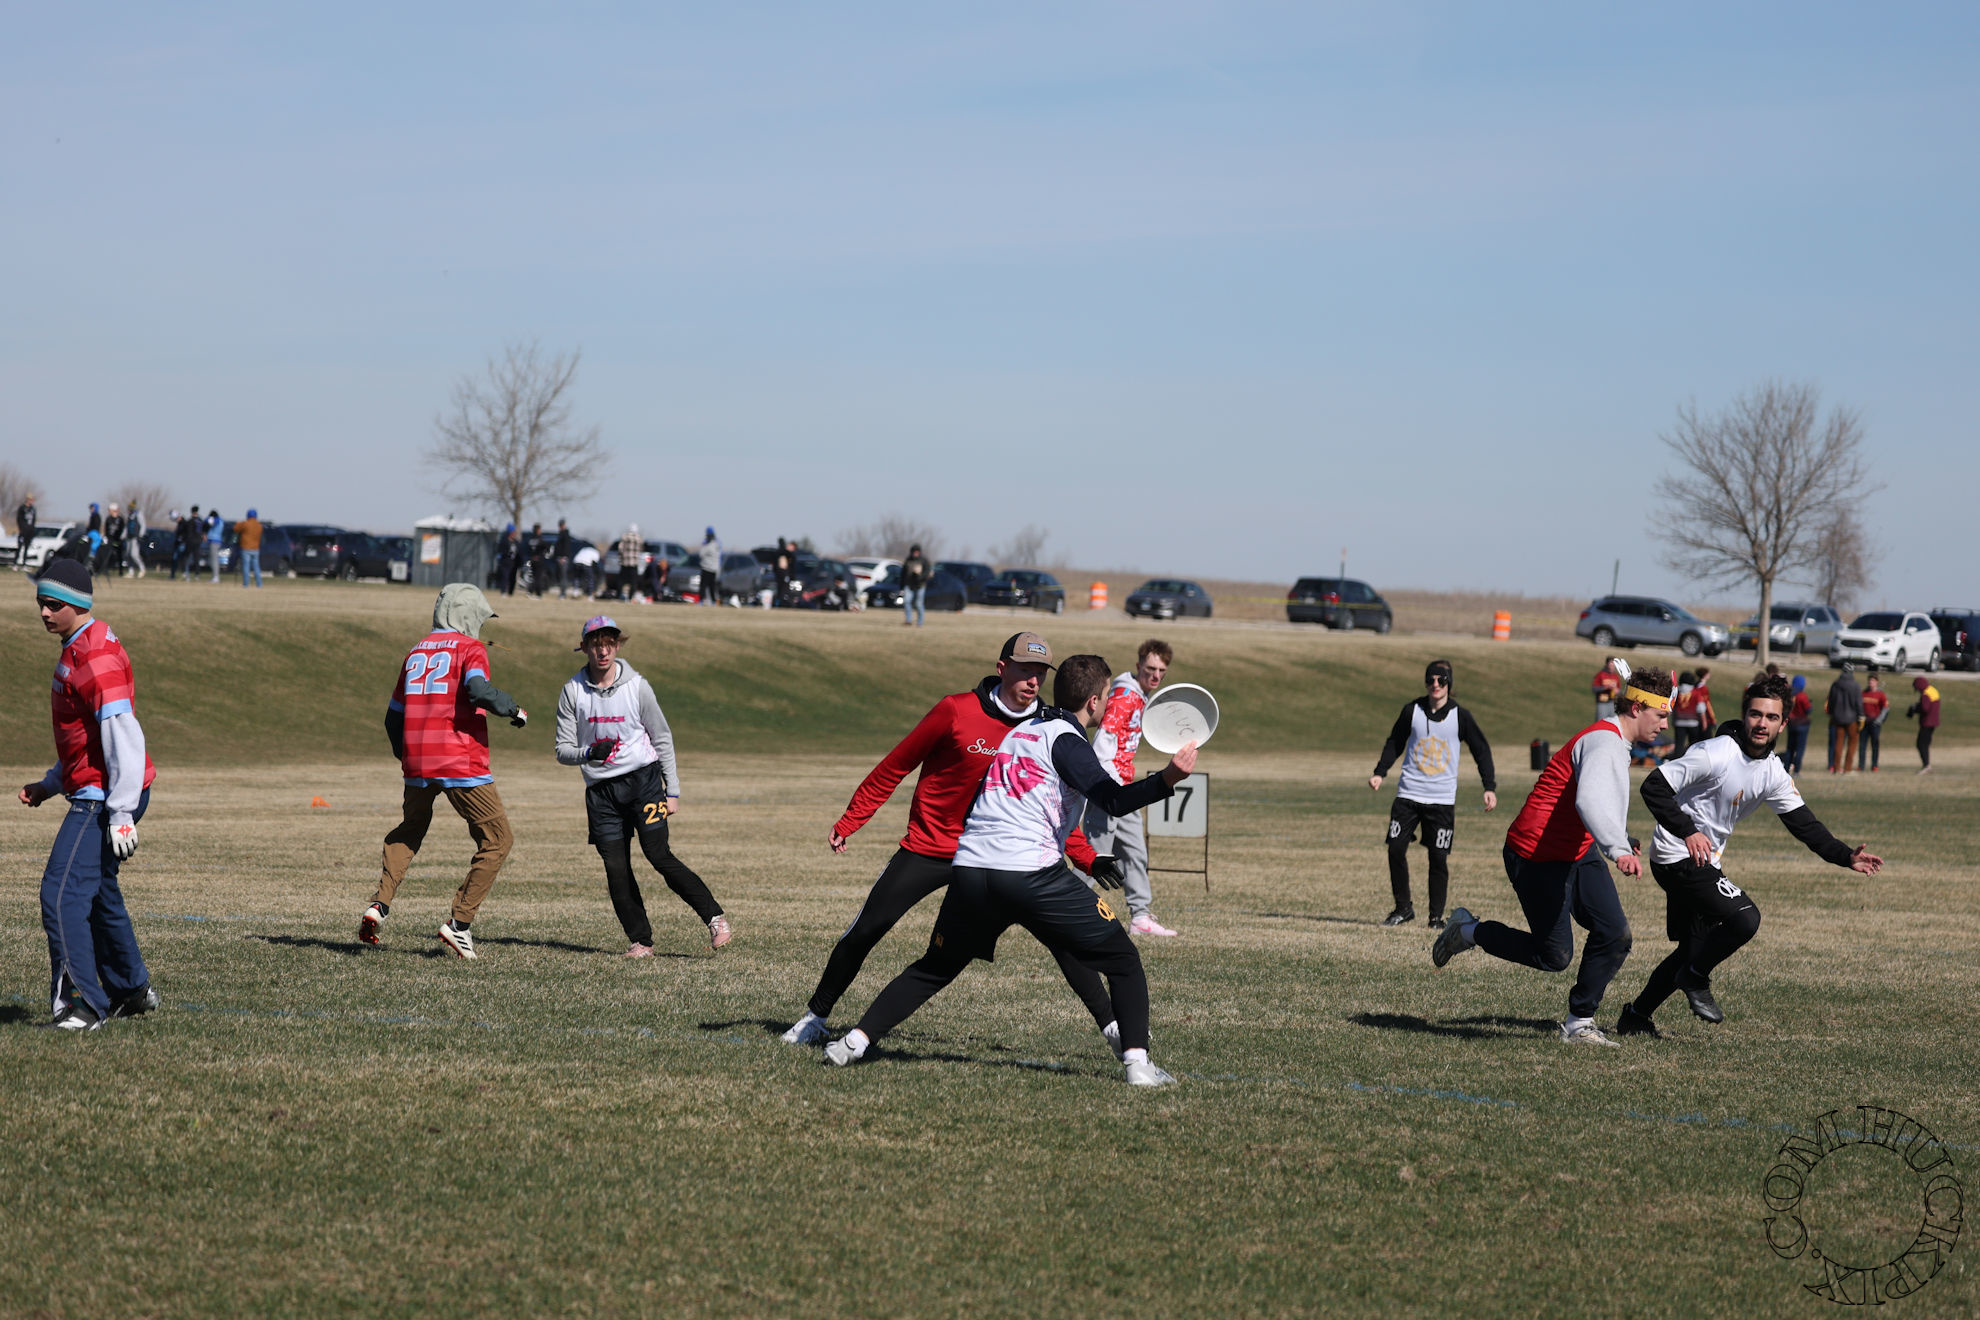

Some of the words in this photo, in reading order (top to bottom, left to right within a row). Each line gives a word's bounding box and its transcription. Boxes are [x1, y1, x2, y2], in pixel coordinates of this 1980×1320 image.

[404, 651, 452, 695] 22
[966, 737, 998, 757] Sain
[643, 801, 668, 824] 25
[1164, 786, 1193, 823] 17
